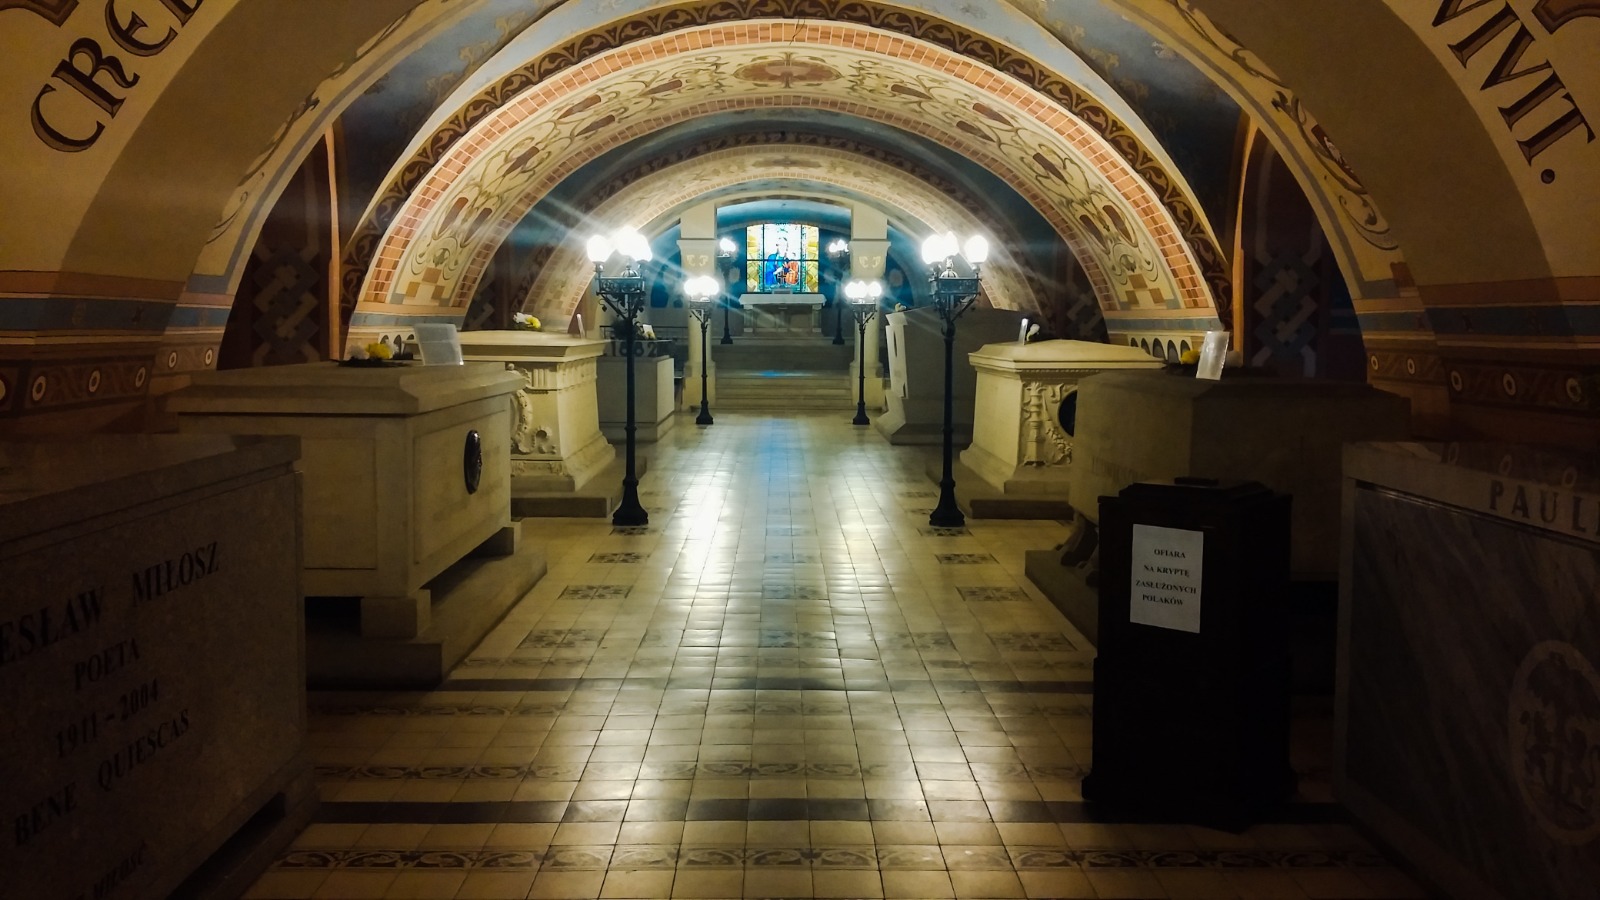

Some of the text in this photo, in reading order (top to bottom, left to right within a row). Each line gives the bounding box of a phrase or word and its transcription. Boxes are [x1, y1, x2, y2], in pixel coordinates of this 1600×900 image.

[1153, 548, 1186, 559] OFIARA
[131, 540, 220, 608] MIŁOSZ
[1143, 564, 1190, 578] NA KRYPTĘ
[1135, 579, 1197, 595] ZASŁUŻONYCH
[1141, 593, 1184, 606] POLAKÓW
[74, 637, 141, 691] POETA
[15, 708, 190, 847] BENE QUIESCAS
